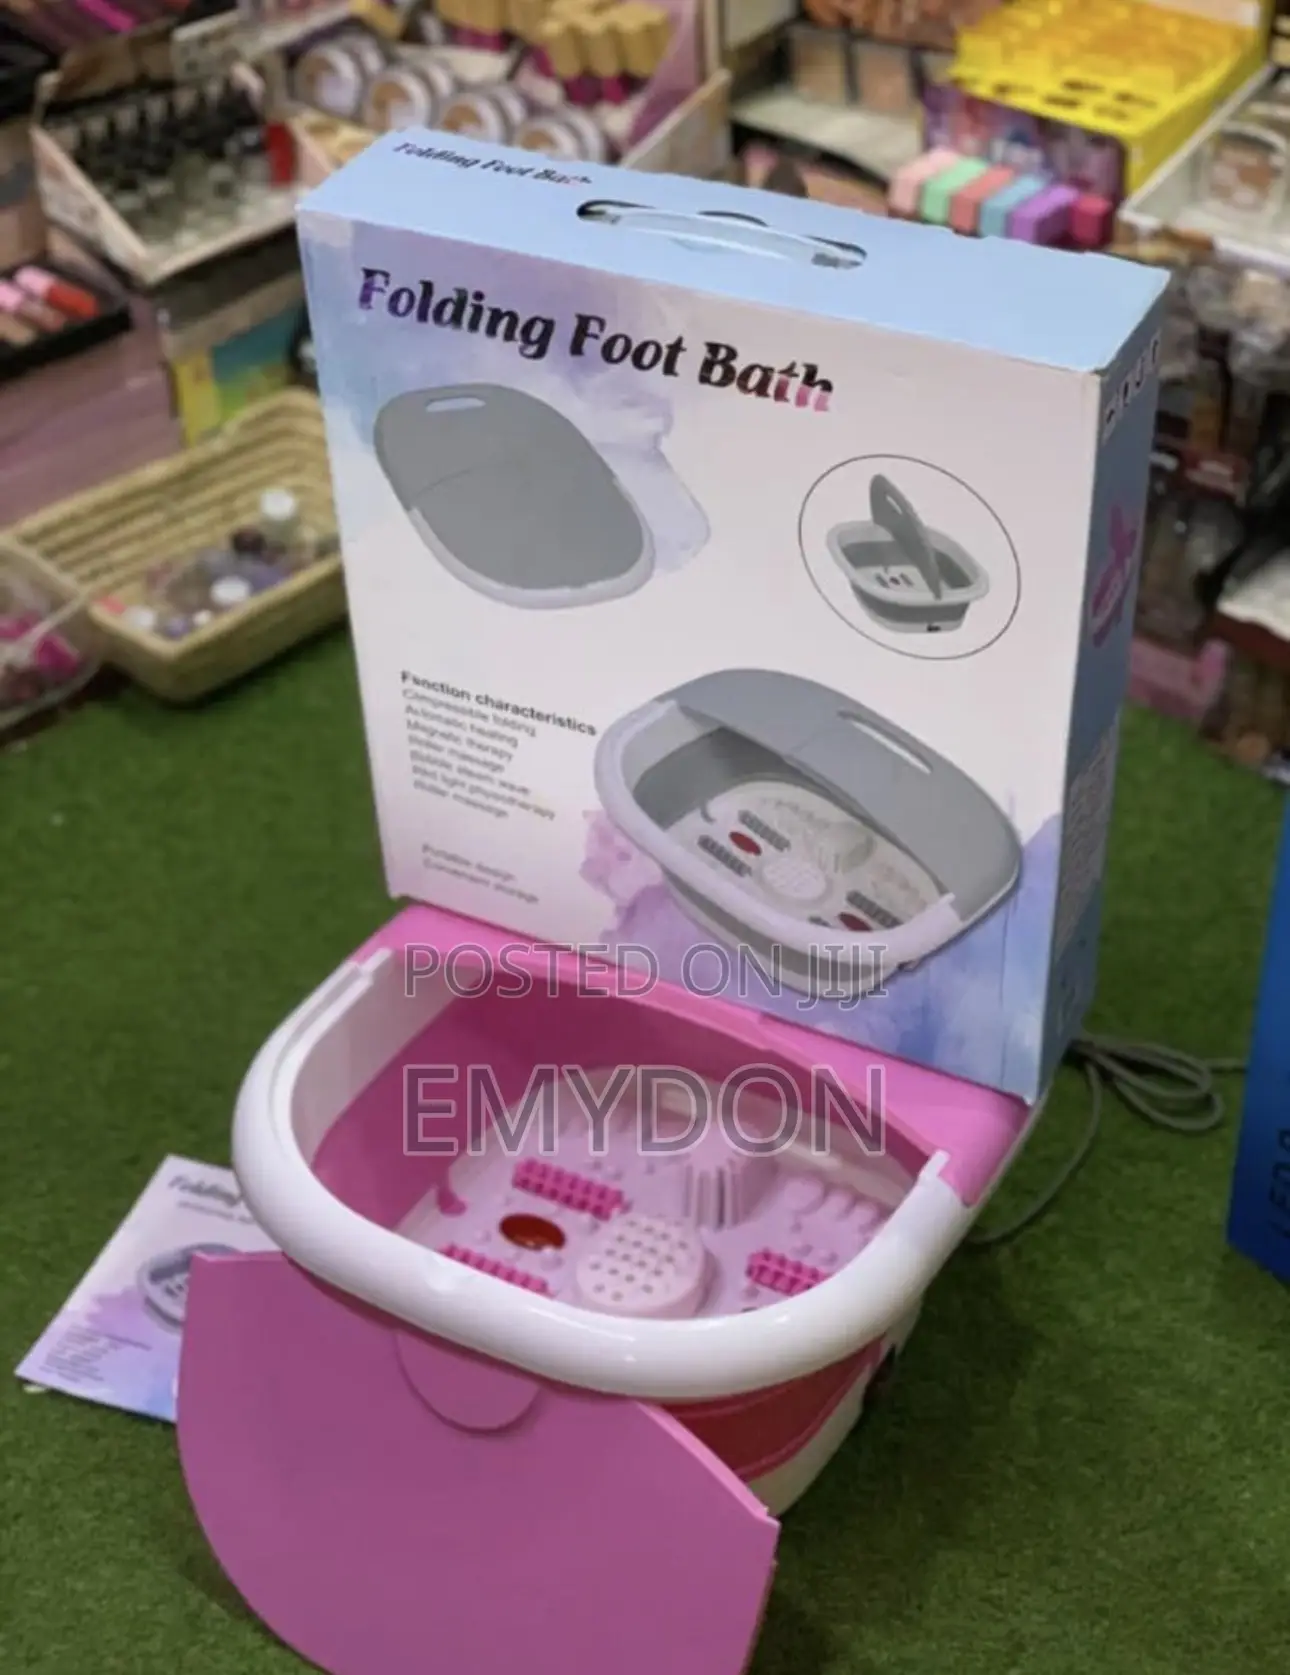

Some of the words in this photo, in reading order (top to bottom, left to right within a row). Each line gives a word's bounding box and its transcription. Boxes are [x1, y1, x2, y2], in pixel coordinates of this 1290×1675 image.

[394, 142, 481, 168] Folding
[359, 267, 555, 360] Folding
[569, 313, 686, 375] Foot
[698, 341, 834, 412] Bath
[475, 693, 597, 736] characteristics
